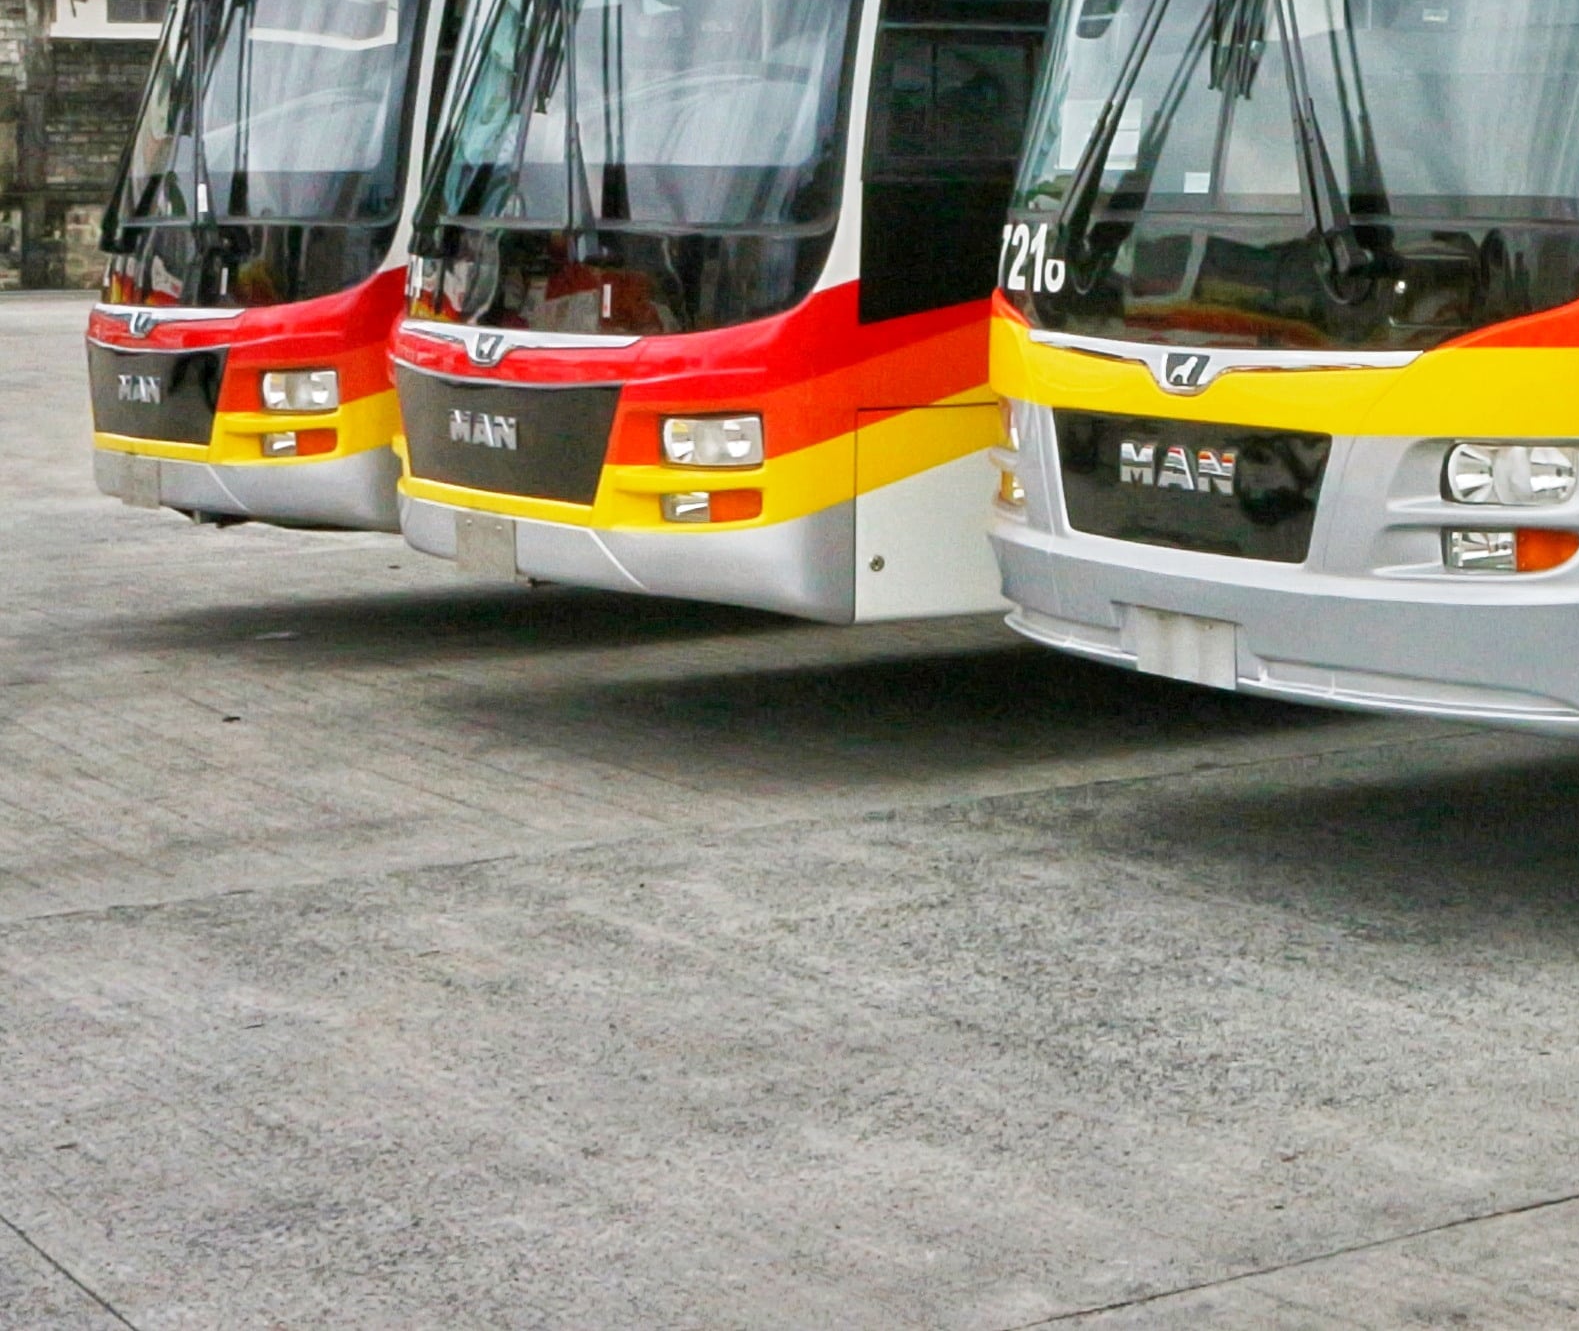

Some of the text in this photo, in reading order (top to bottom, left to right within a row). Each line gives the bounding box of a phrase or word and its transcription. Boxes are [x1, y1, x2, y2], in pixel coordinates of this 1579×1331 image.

[118, 374, 161, 404] MAN
[449, 409, 518, 450] MAN
[1120, 441, 1238, 496] MAN
